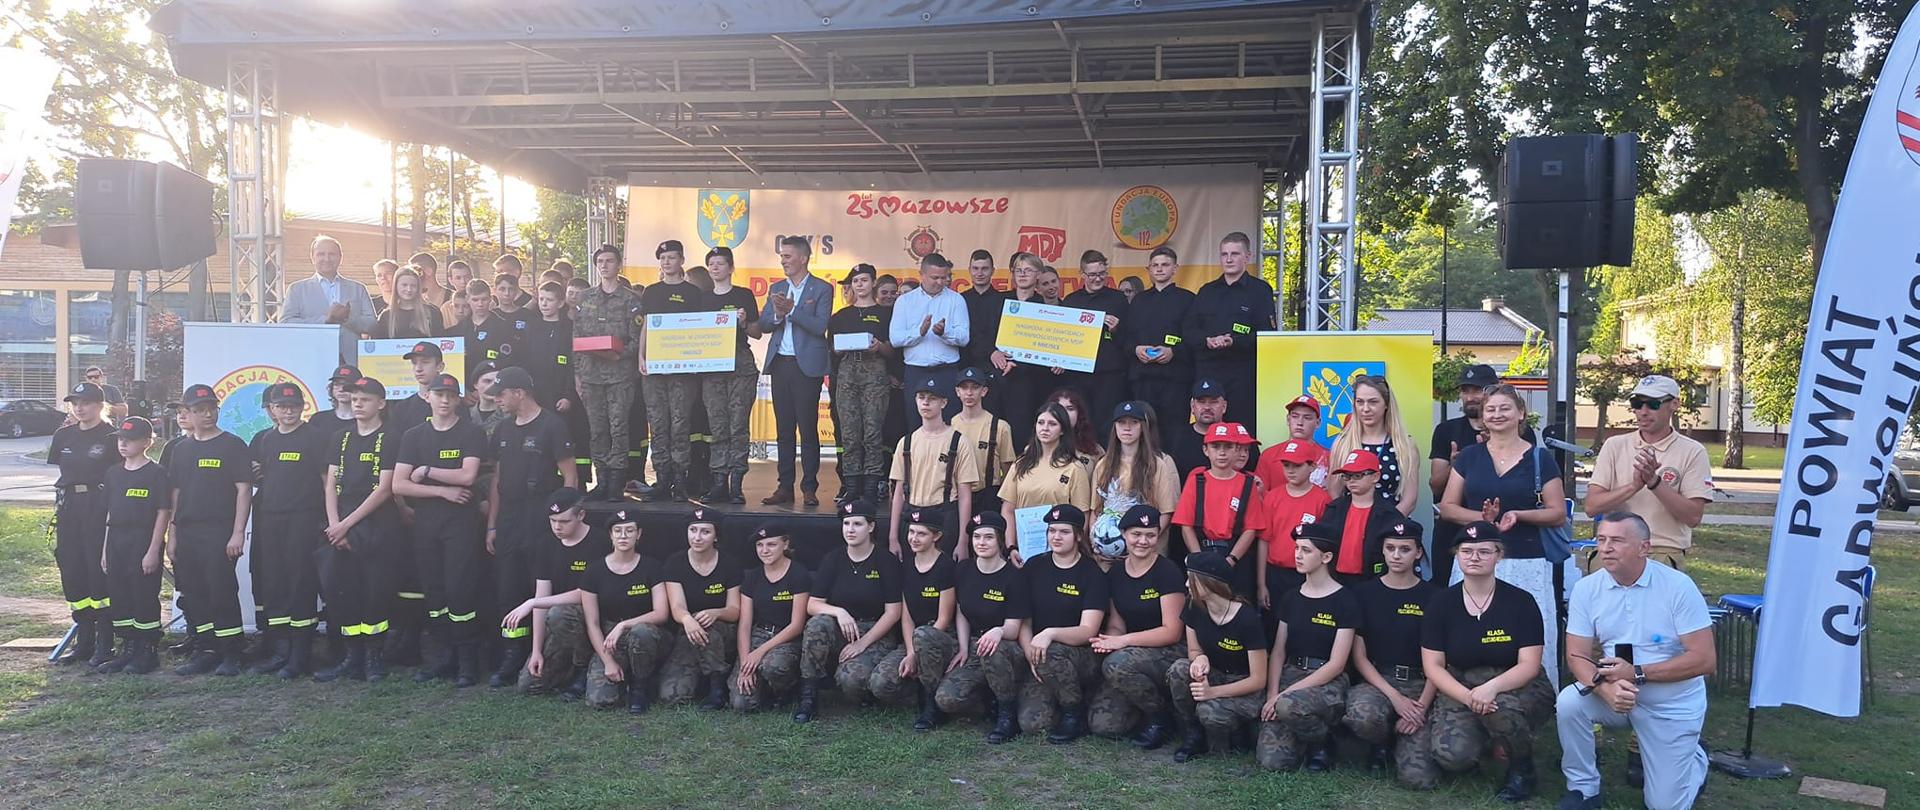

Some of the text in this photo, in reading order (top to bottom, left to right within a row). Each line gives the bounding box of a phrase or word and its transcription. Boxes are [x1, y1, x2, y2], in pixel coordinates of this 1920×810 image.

[1139, 230, 1151, 246] 112
[215, 371, 269, 400] DACJA
[1788, 295, 1880, 538] POWIAT
